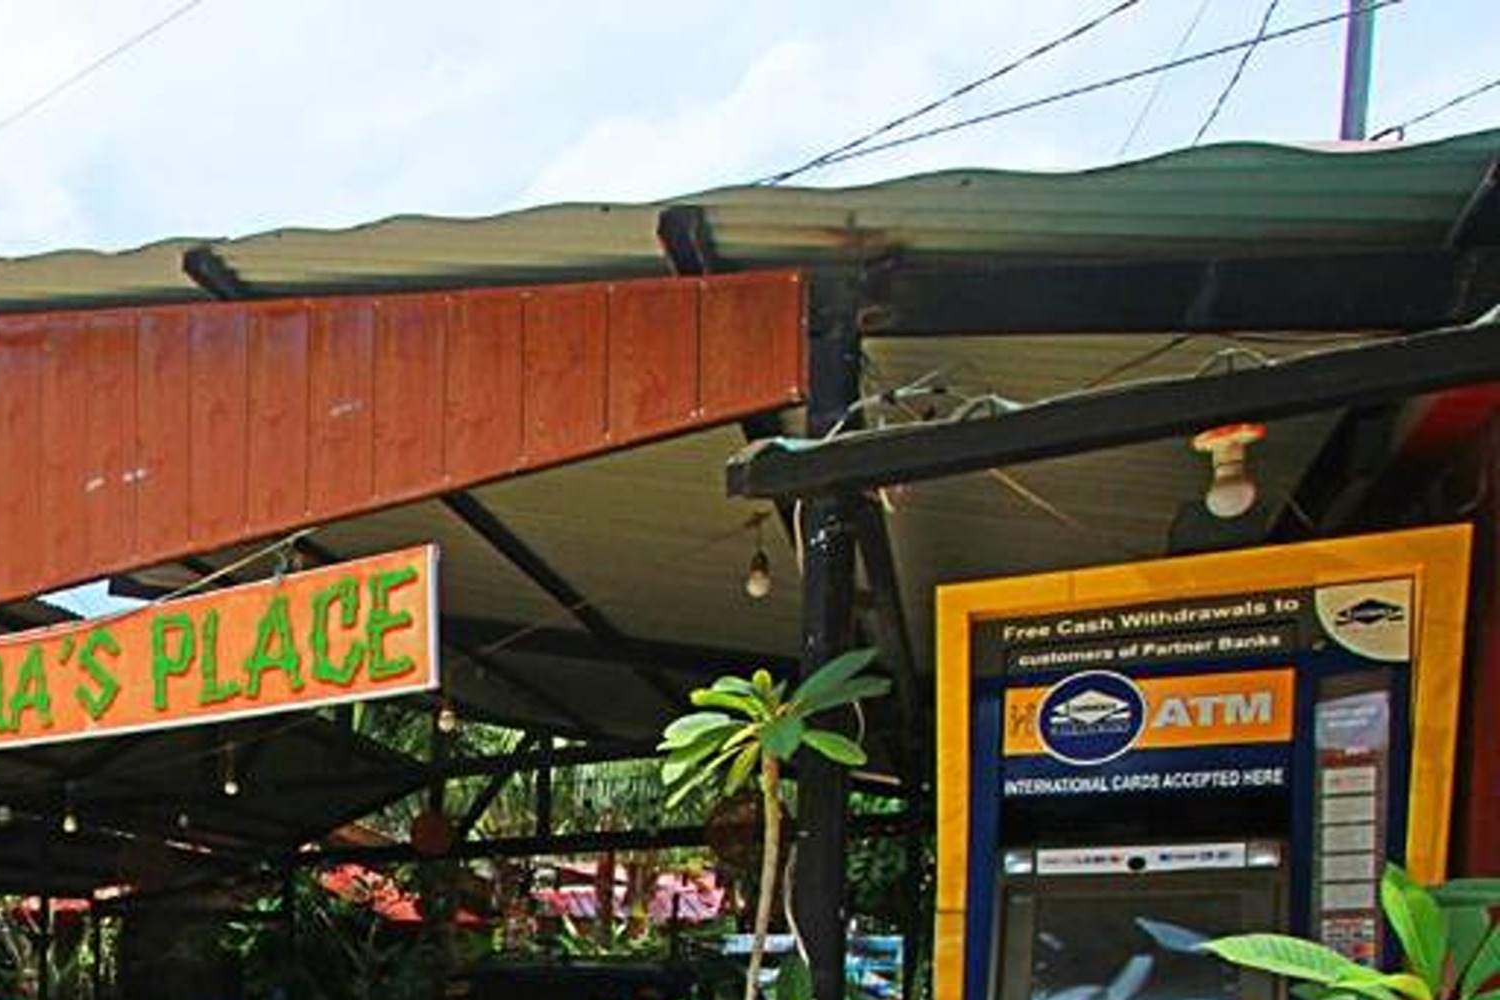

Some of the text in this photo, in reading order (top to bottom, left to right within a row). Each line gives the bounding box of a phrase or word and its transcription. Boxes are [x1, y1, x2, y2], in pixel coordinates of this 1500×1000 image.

[1002, 598, 1301, 642] Free Cash Withdrawals to
[150, 565, 419, 713] PLACE
[1017, 633, 1282, 667] customers of Partner Banks
[1153, 691, 1274, 728] ATM
[1003, 766, 1285, 796] INTERNATIONAL CARDS ACCEPTED HERE
